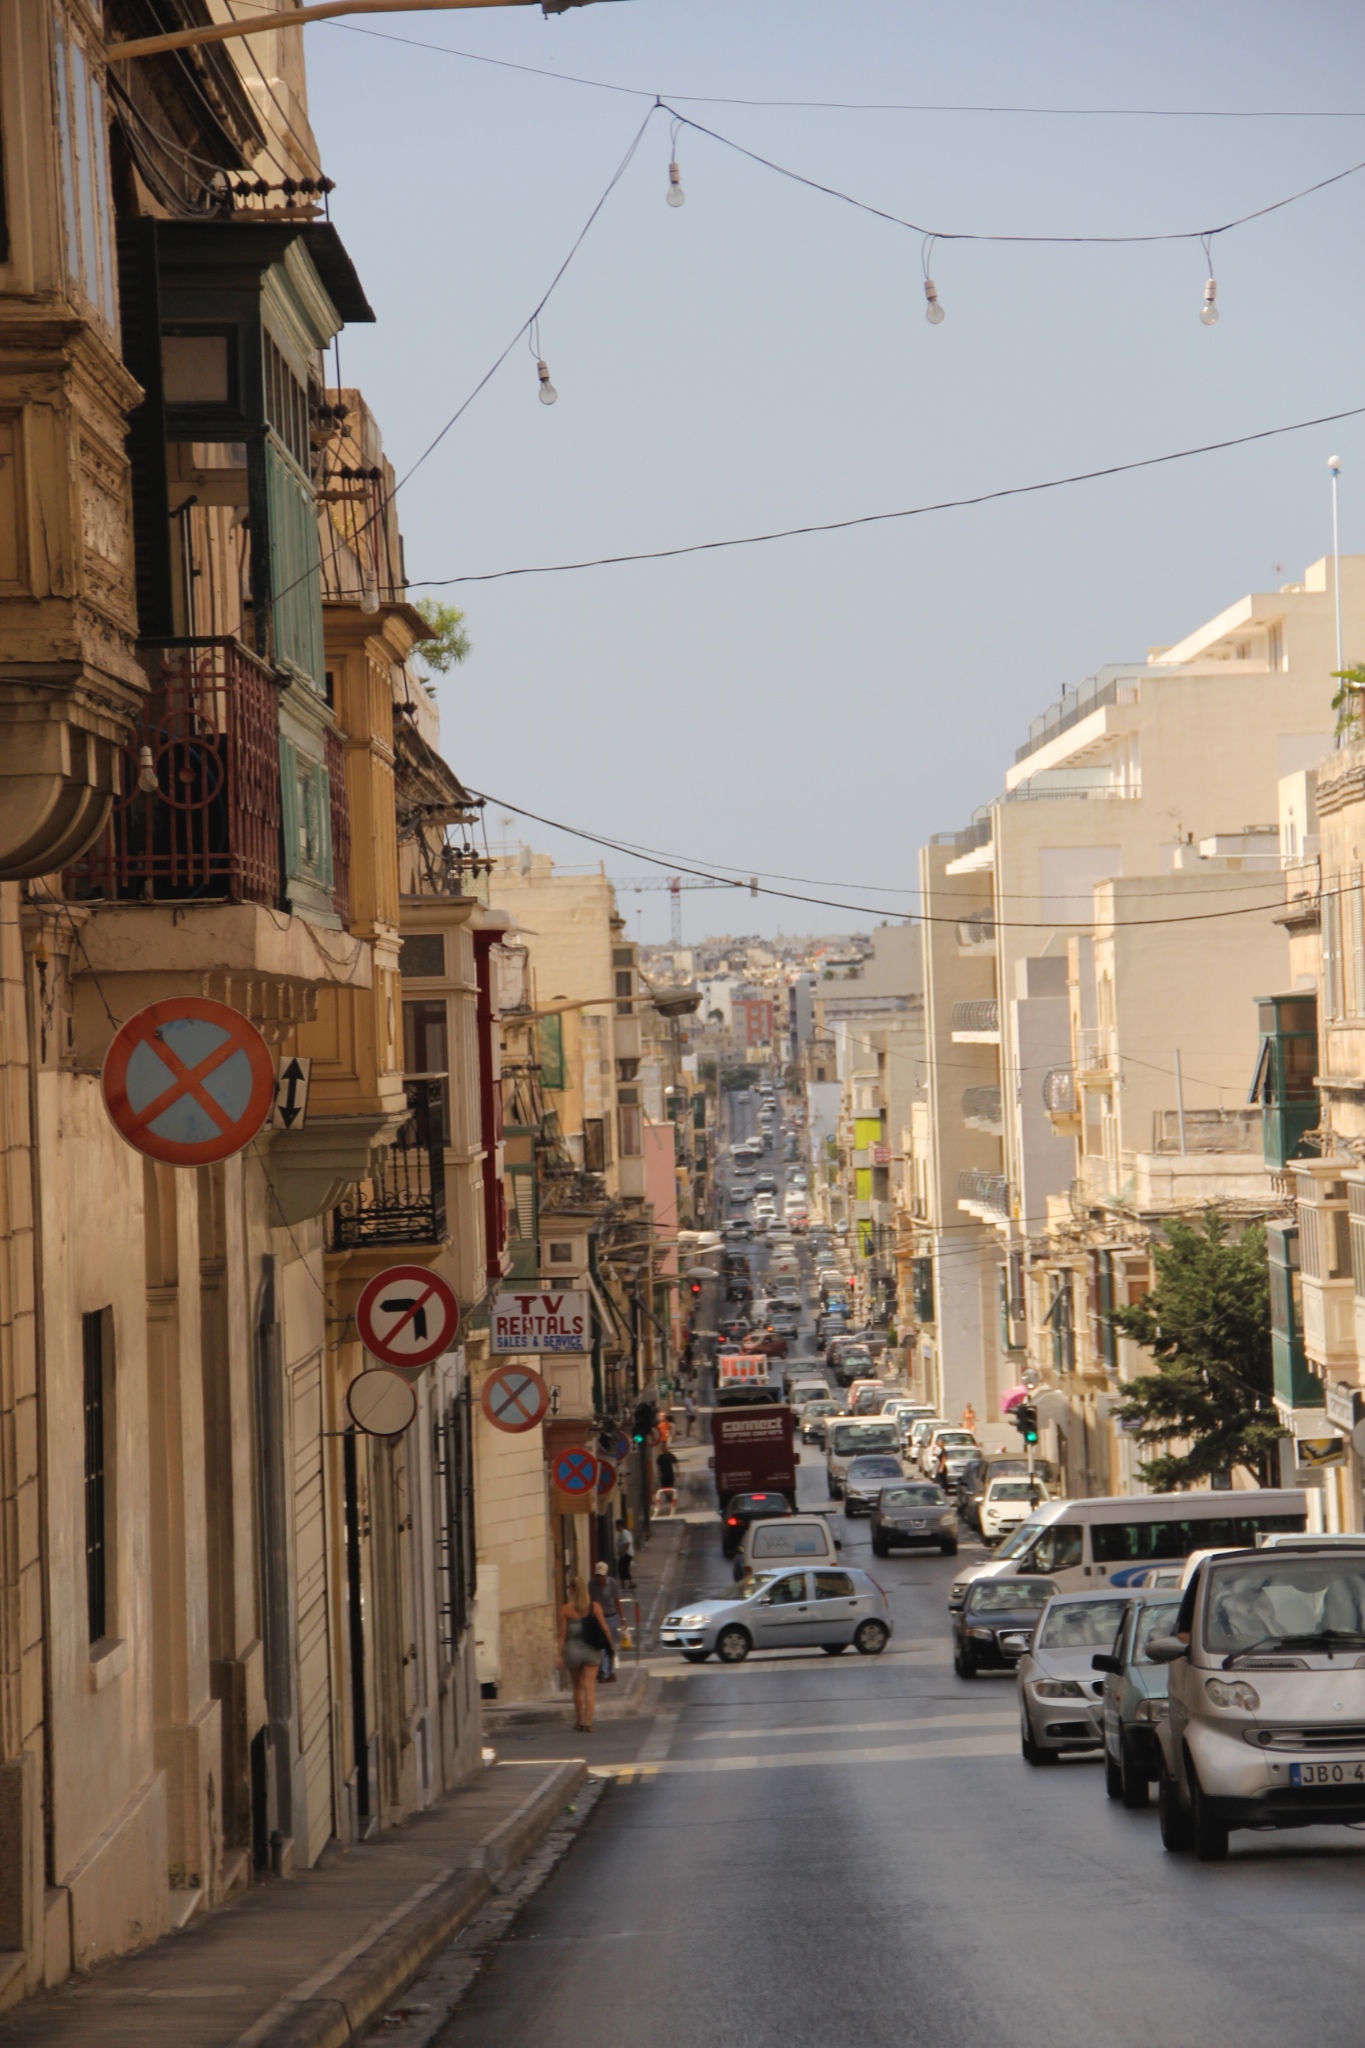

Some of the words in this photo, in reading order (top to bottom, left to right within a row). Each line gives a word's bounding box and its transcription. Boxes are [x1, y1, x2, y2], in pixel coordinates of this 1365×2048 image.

[514, 1295, 564, 1315] TV
[496, 1315, 584, 1335] RENTALS
[497, 1336, 528, 1348] SALES
[532, 1336, 539, 1348] &
[543, 1335, 583, 1347] SERVICE
[722, 1417, 783, 1432] connect
